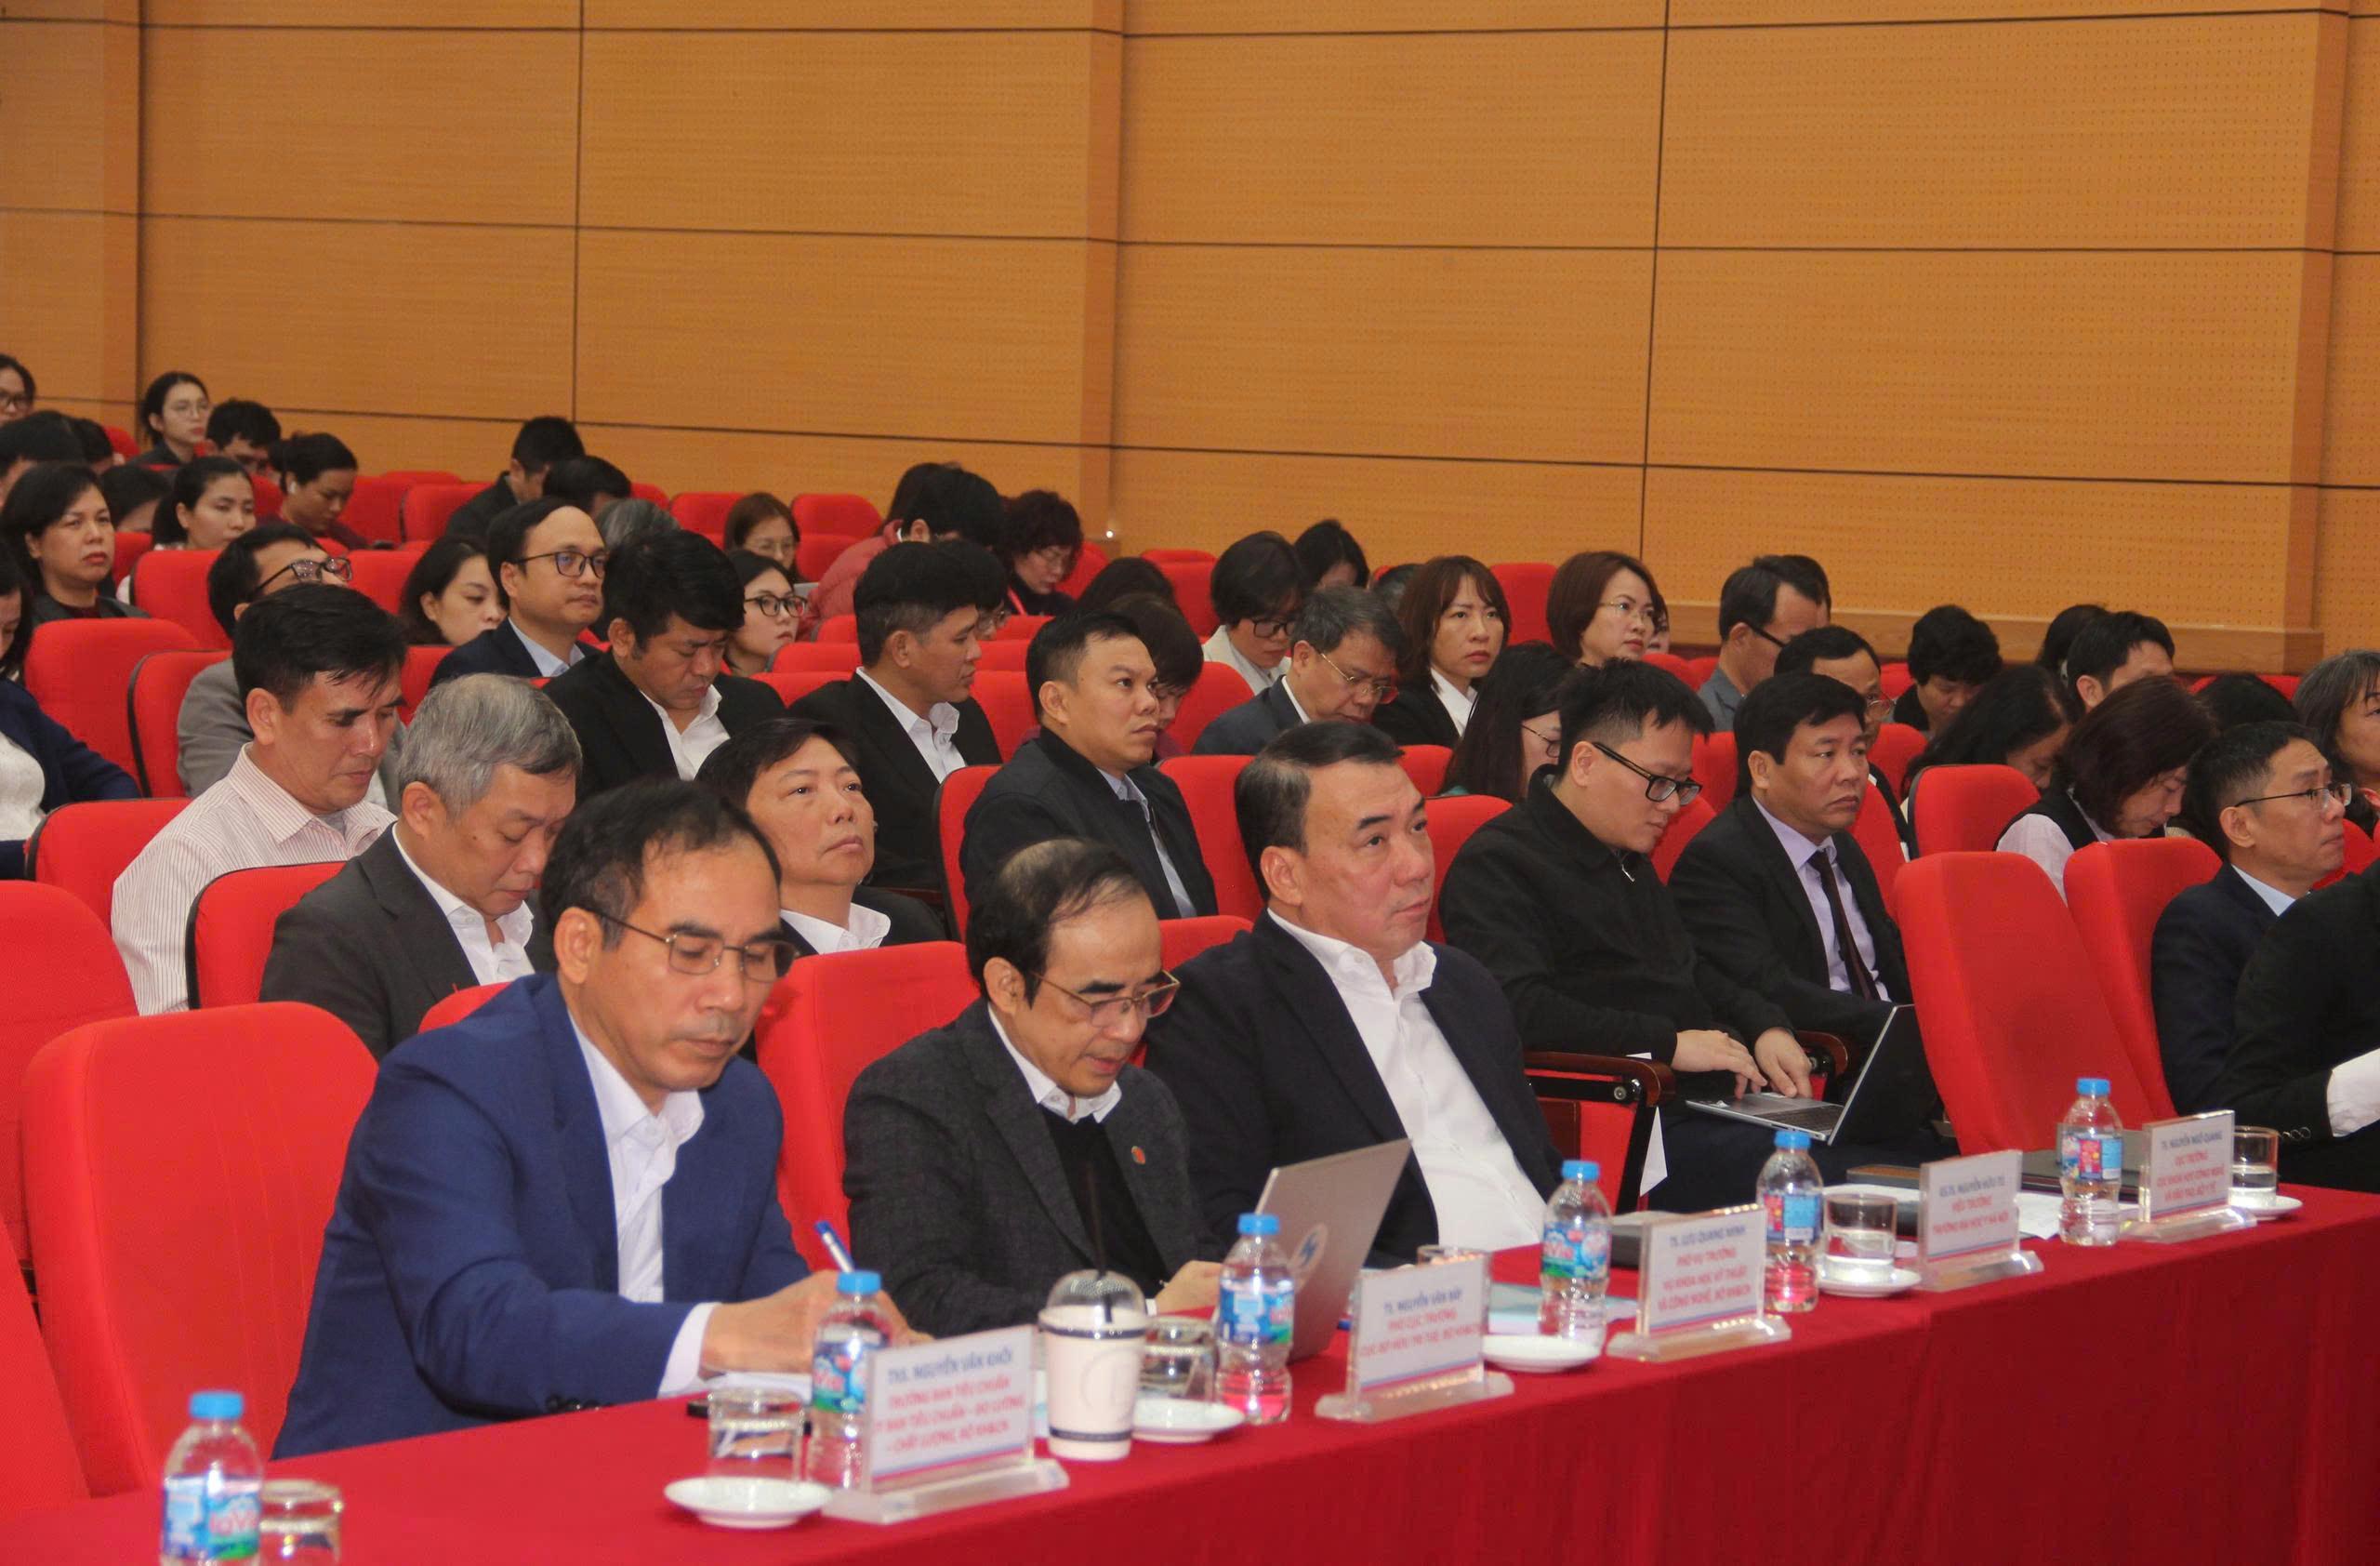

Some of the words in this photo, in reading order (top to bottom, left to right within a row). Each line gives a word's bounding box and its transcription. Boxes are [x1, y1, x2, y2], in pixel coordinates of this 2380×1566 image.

[1397, 1291, 1429, 1312] NGUYỄN
[1424, 1307, 1458, 1326] TRƯỞNG
[913, 1355, 958, 1380] NGUYỄN
